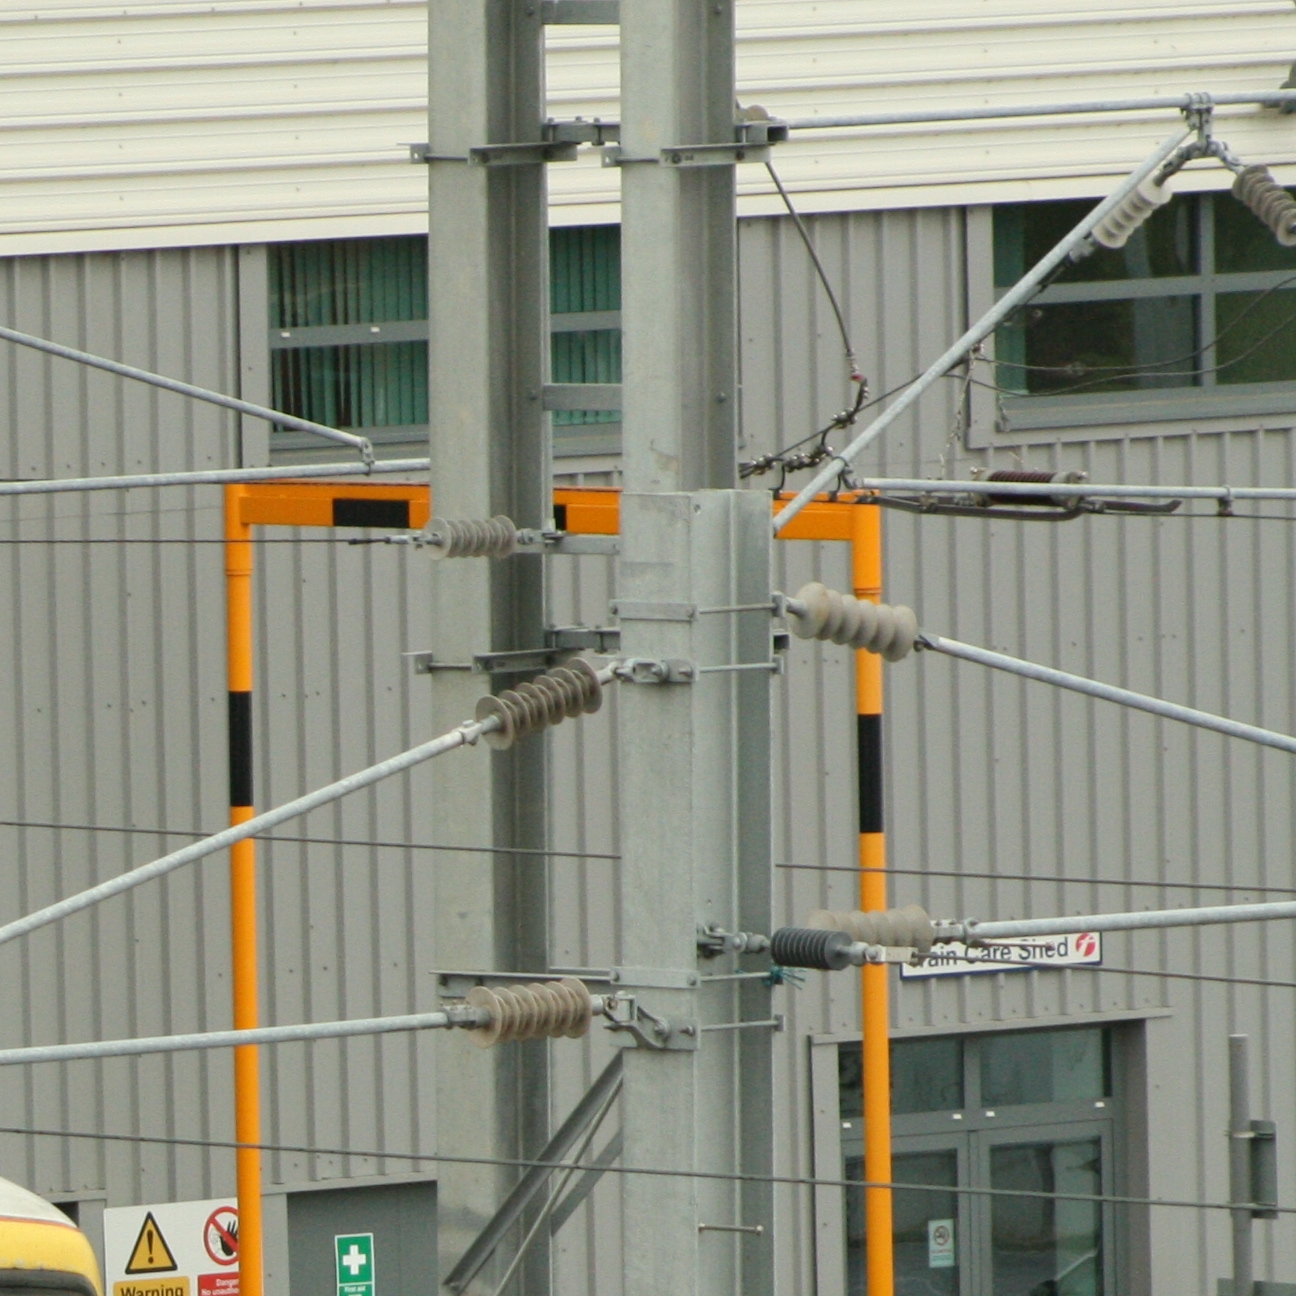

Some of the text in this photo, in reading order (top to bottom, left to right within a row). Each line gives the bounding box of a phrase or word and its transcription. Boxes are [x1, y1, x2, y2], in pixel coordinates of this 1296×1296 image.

[918, 937, 1068, 967] ain Care Shed
[201, 1288, 212, 1296] No
